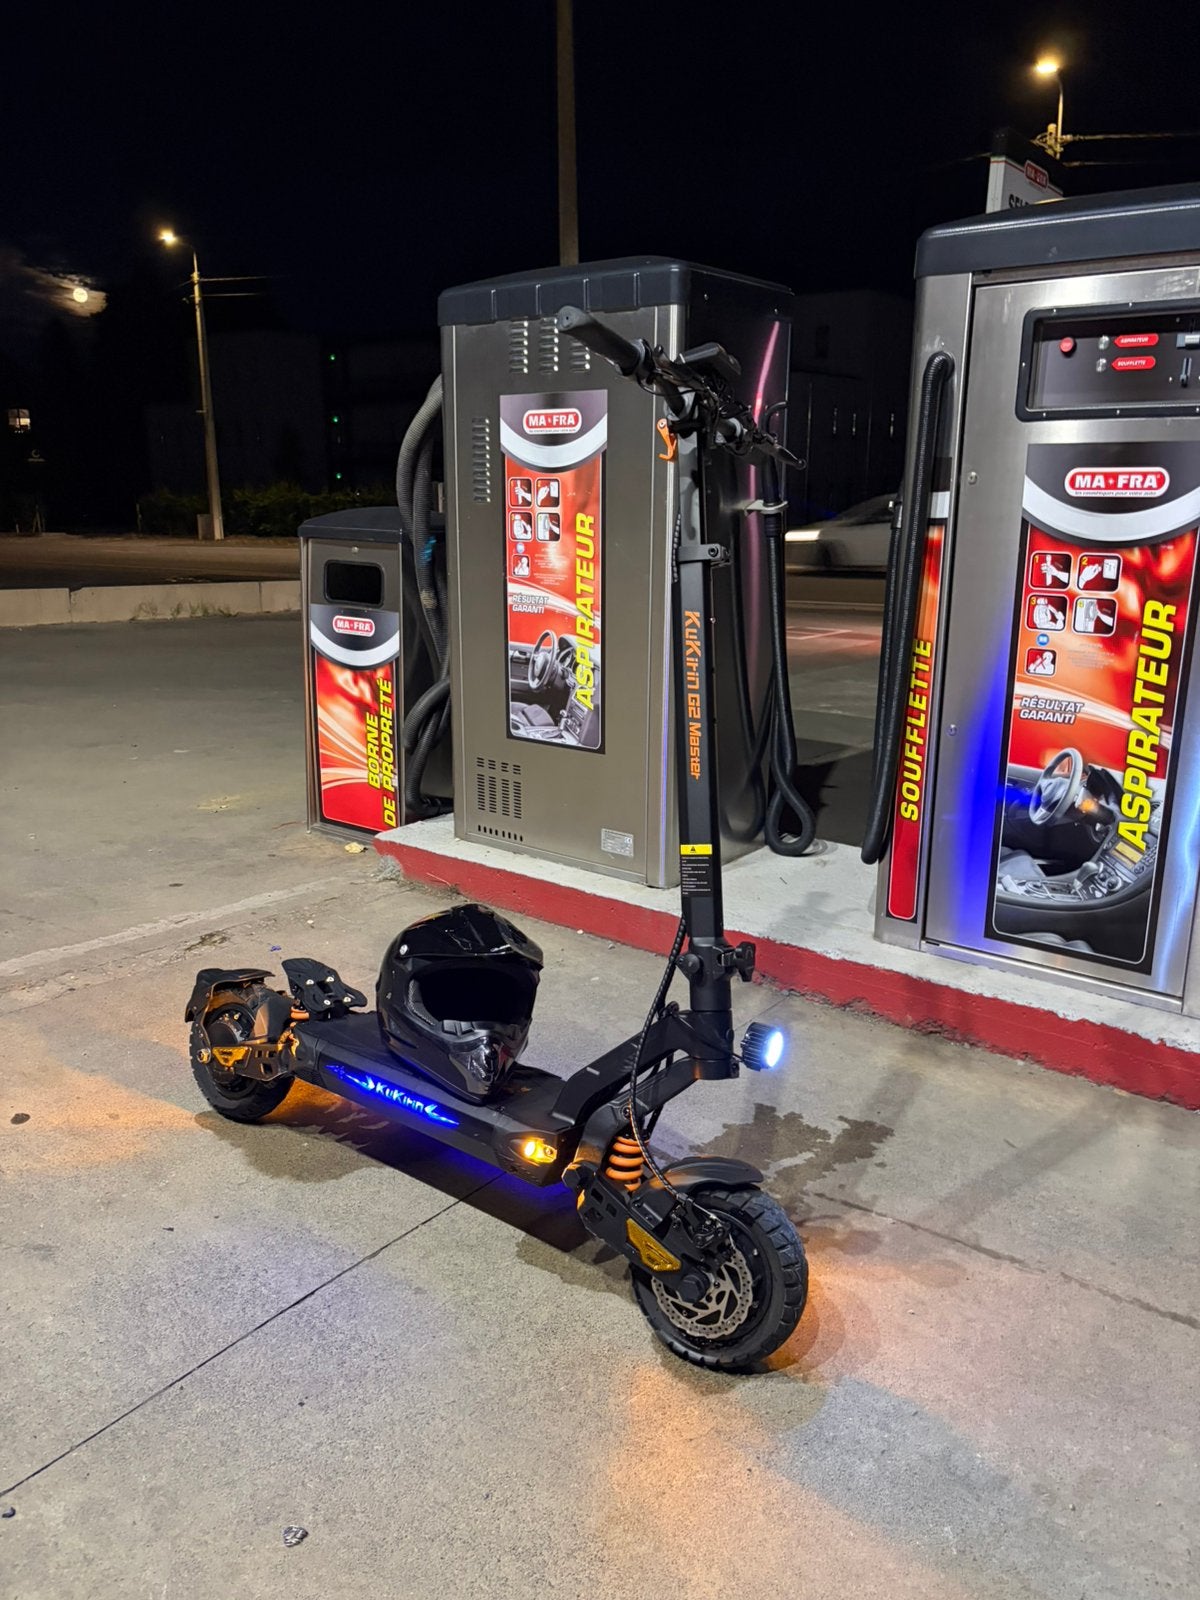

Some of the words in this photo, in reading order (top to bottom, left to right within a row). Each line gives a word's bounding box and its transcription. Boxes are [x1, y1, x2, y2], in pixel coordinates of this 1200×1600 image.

[511, 593, 549, 605] RÉSULTAT
[511, 604, 545, 614] GARANTI
[576, 512, 595, 711] ASPIRATEUR
[684, 610, 702, 691] KuKirin
[687, 693, 701, 719] G2
[1019, 709, 1076, 724] GARANTI
[1020, 695, 1084, 713] RÉSULTAT
[1117, 600, 1176, 852] ASPIRATEUR
[366, 712, 380, 789] BORNE
[377, 678, 393, 792] PROPRETÉ
[689, 722, 702, 780] Master
[900, 638, 932, 822] SOUFFLETTE
[383, 796, 397, 828] DE
[376, 1082, 424, 1112] KuKirin
